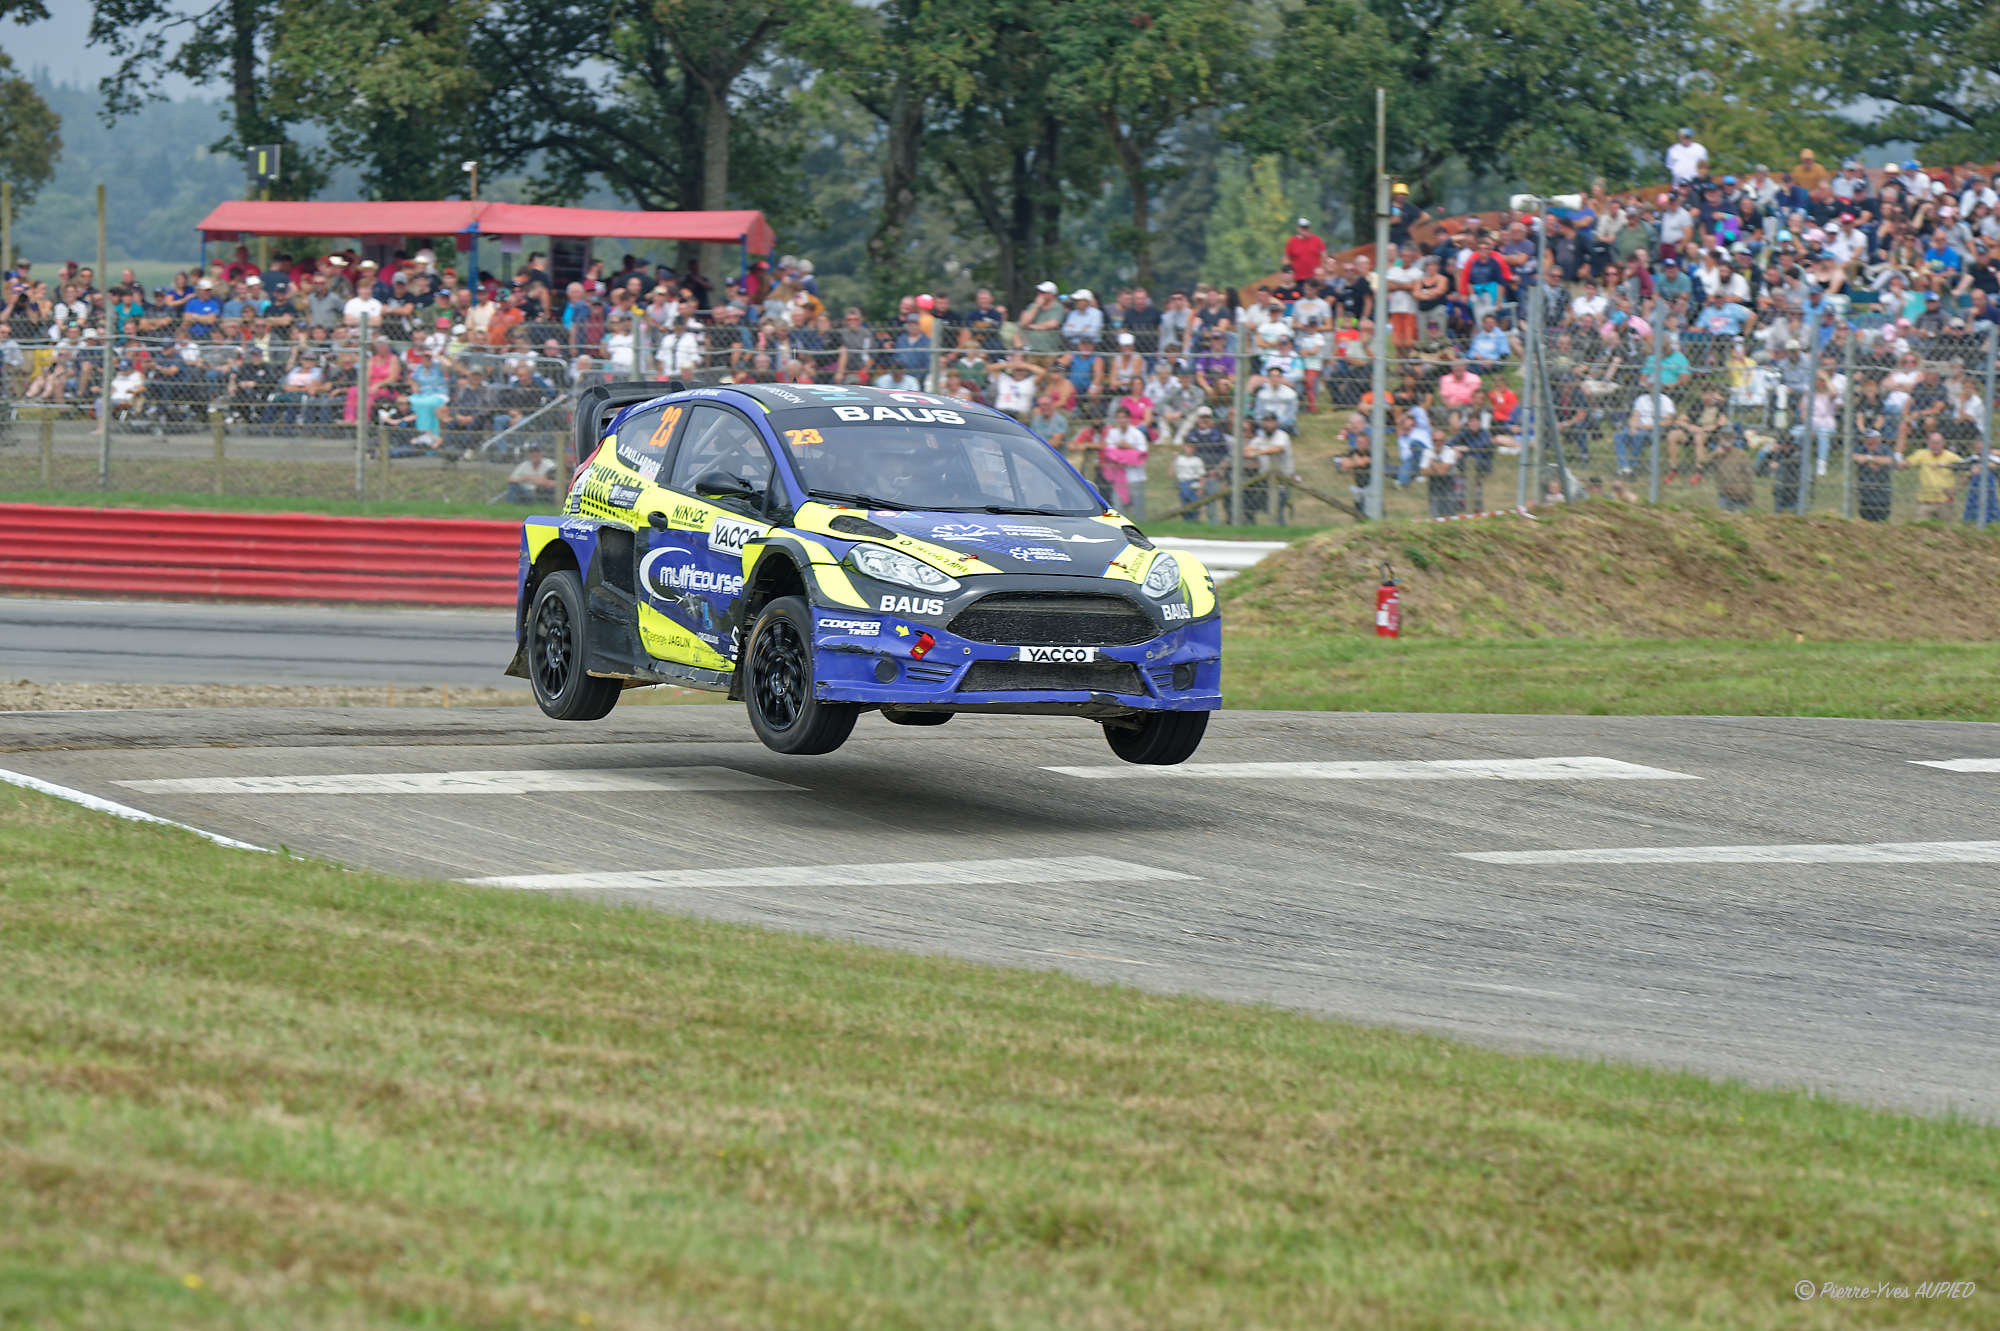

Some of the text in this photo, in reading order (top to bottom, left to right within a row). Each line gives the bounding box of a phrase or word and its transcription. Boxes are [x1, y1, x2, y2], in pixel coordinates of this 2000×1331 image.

[832, 406, 966, 425] BAUS
[649, 406, 683, 448] 23
[784, 428, 824, 446] 23
[659, 563, 744, 596] multicourse
[880, 595, 944, 616] BAUS
[1161, 603, 1192, 620] BAUS
[819, 618, 881, 630] COOPER
[847, 628, 880, 636] TIRES
[1028, 648, 1087, 662] YACCO
